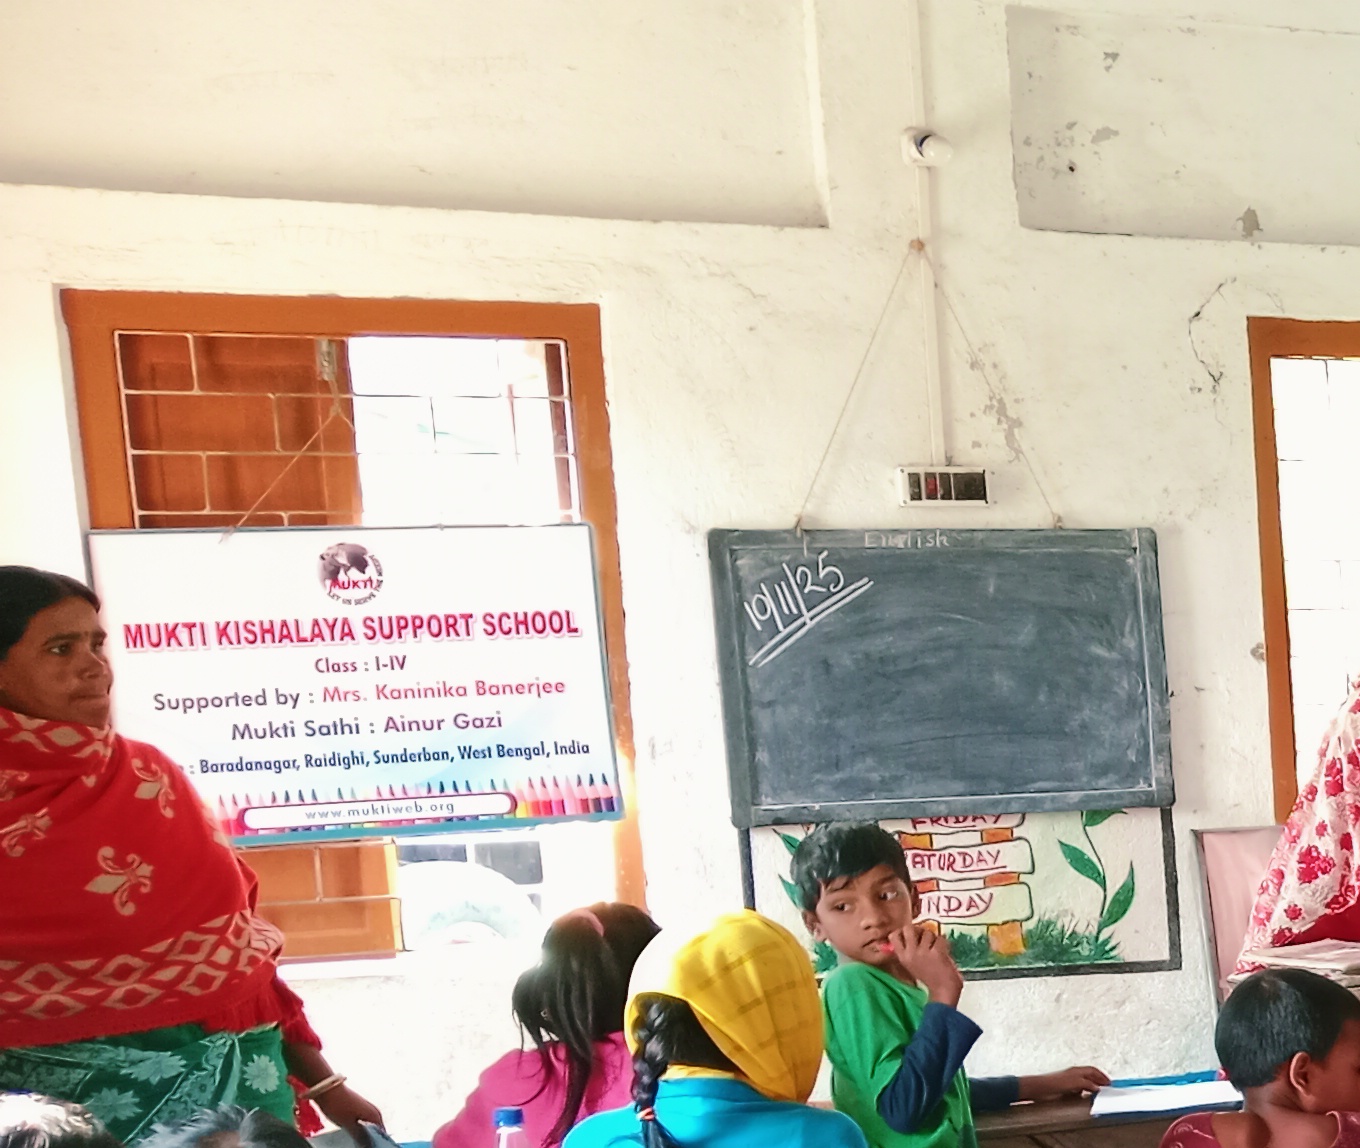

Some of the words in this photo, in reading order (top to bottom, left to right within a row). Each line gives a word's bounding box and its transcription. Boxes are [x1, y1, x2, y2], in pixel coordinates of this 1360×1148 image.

[330, 576, 373, 590] MUKTI
[743, 550, 844, 632] 10/11/25
[123, 621, 207, 649] MUKTI
[215, 617, 356, 646] KISHALAYA
[362, 613, 474, 641] SUPPORT
[482, 609, 579, 637] SCHOOL
[314, 657, 358, 673] Class
[375, 655, 407, 671] I-IV
[153, 688, 267, 714] Supported
[275, 688, 300, 709] by
[322, 686, 367, 703] Mrs.
[376, 680, 467, 700] Kaninika
[475, 676, 566, 698] Banerjee
[231, 720, 296, 740] Mukti
[304, 717, 360, 737] Sathi
[384, 715, 445, 733] Ainur
[453, 710, 503, 730] Gazi
[199, 756, 300, 773] Baradanagar,
[304, 750, 370, 769] Raidighi,
[374, 747, 455, 764] Sunderban,
[457, 744, 493, 760] West
[495, 741, 550, 761] Bengal,
[554, 740, 590, 756] India
[305, 801, 454, 820] www.muktiweb.org
[904, 850, 1006, 873] ATURDAY
[919, 893, 993, 918] NDAY
